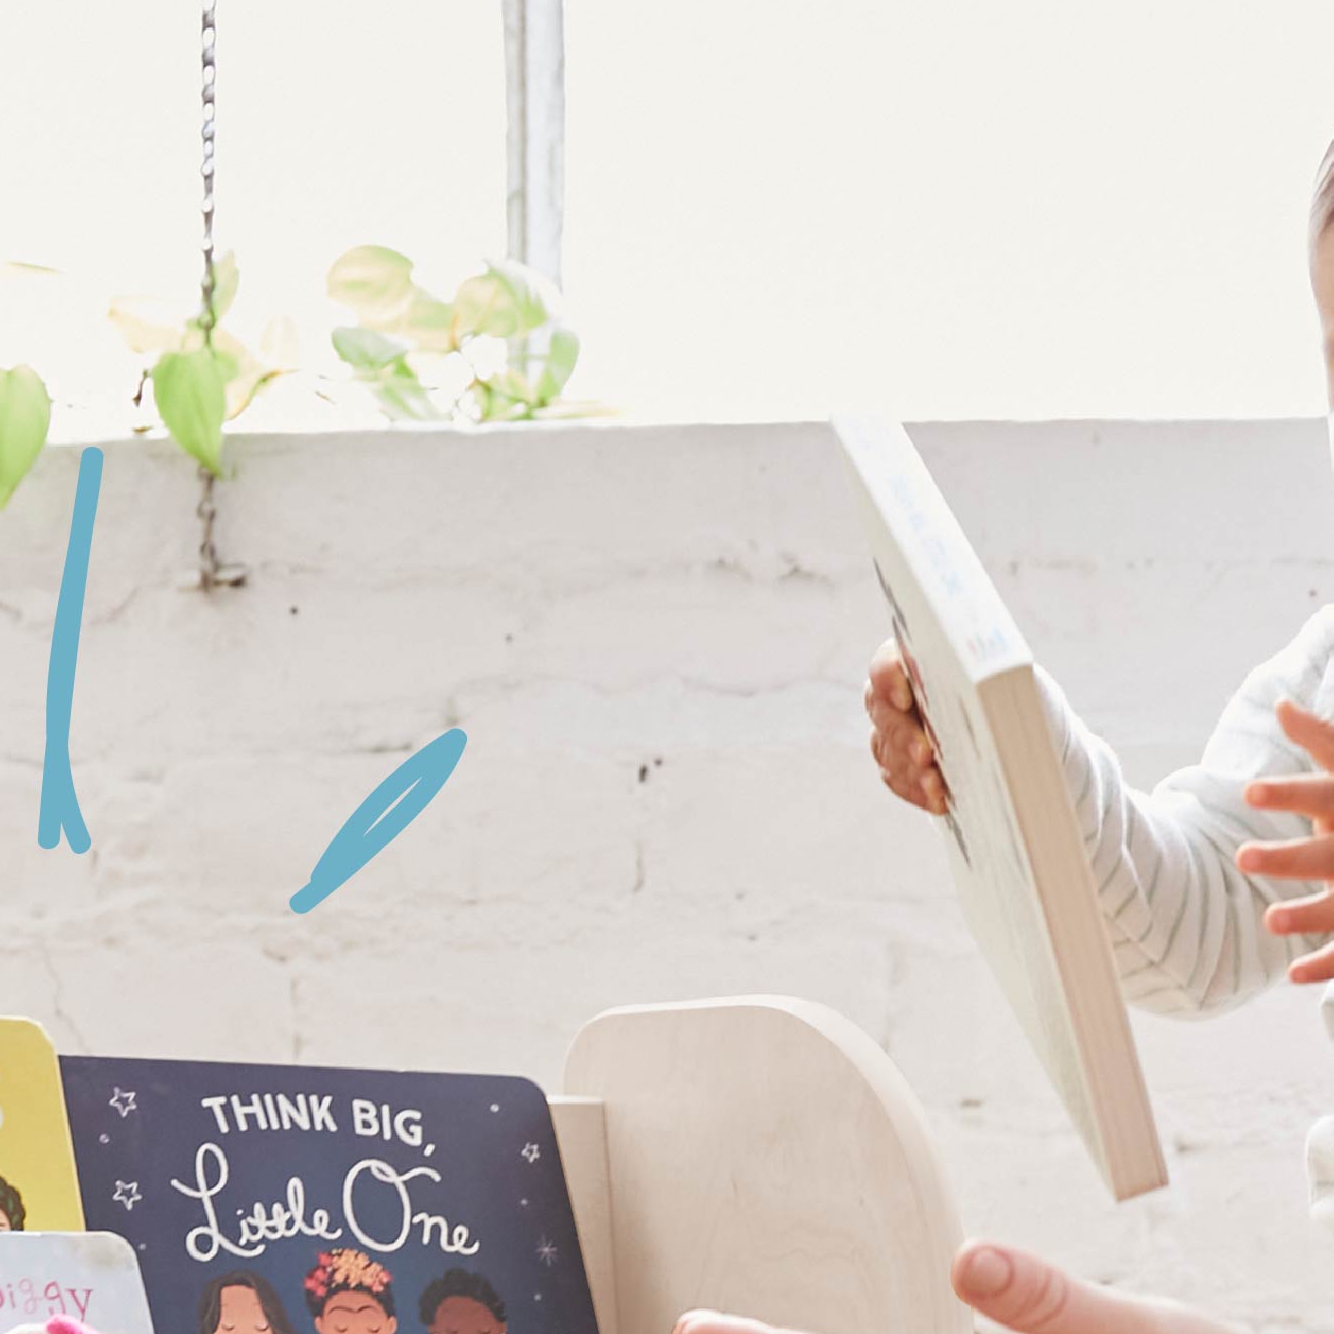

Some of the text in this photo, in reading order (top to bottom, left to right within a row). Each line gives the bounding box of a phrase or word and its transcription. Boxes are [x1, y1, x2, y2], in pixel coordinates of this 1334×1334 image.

[201, 1093, 435, 1157] THINK BIG,
[170, 1142, 480, 1262] Little One
